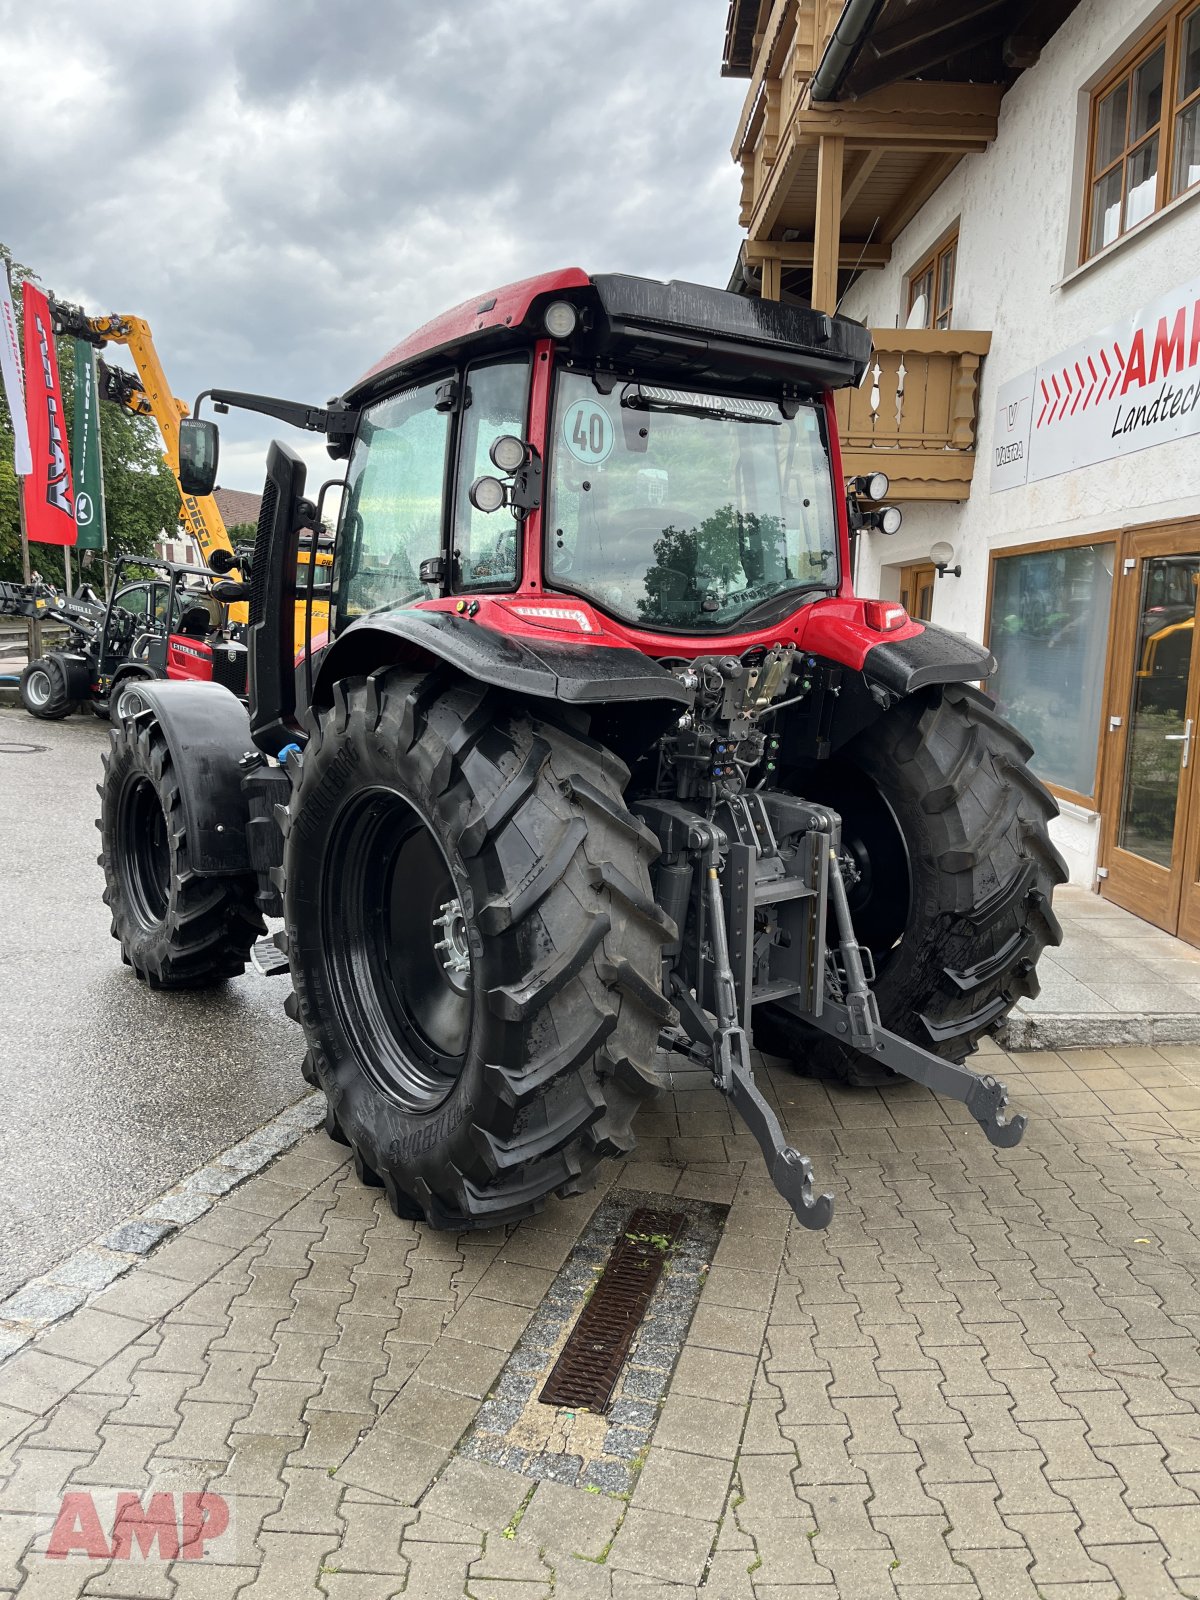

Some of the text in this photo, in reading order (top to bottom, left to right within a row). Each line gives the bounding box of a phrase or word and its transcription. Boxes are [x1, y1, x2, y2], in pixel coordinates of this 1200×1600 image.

[693, 394, 722, 408] AMP
[572, 410, 604, 454] 40
[995, 441, 1024, 467] VALTRA
[186, 496, 211, 548] DIECI
[68, 603, 93, 615] PITBULL
[173, 643, 199, 657] PITBULL
[293, 737, 360, 840] TRELLEBORG
